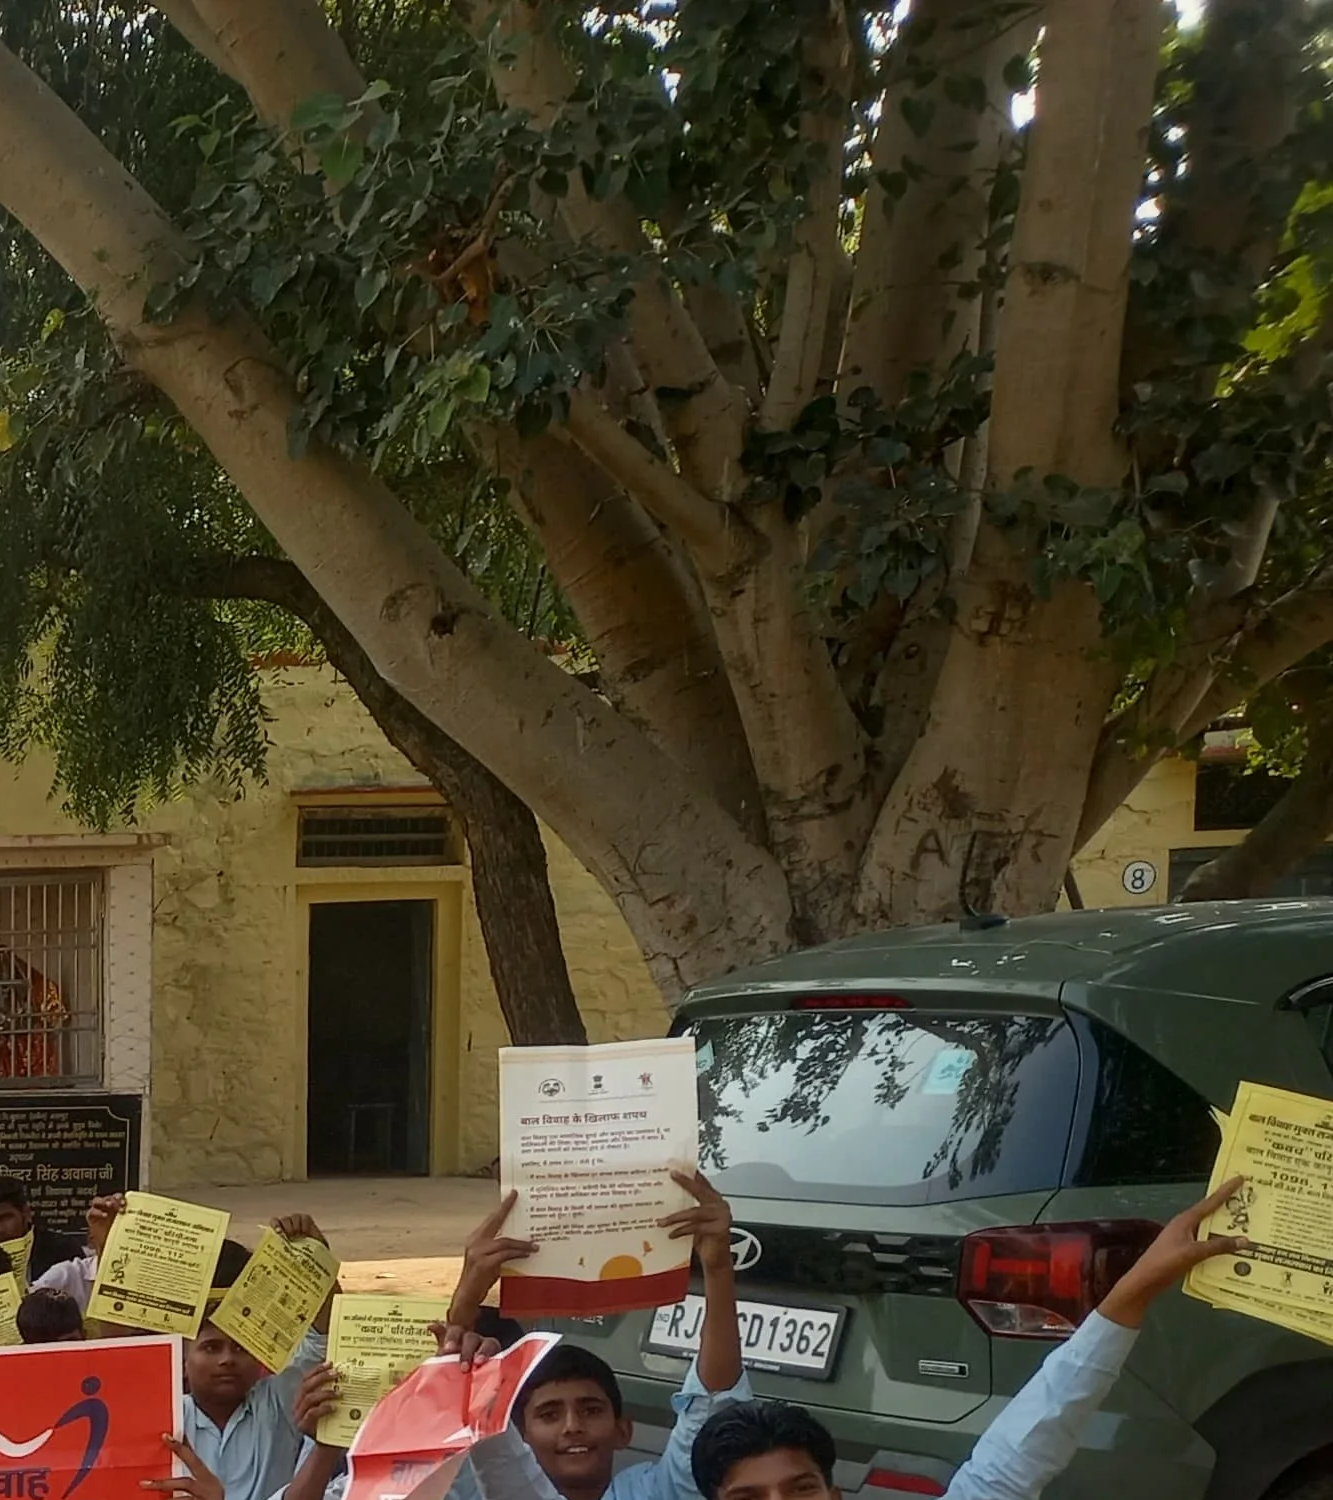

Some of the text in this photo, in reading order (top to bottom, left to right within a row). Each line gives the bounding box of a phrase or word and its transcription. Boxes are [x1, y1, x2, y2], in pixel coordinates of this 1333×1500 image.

[1130, 868, 1145, 890] 8
[520, 1116, 539, 1126] बाल
[542, 1114, 570, 1125] विवाह
[573, 1113, 582, 1123] के
[584, 1113, 620, 1124] खिलाफ
[1315, 1149, 1333, 1162] परि
[37, 1163, 60, 1182] सिंह
[61, 1167, 97, 1181] अवाना
[98, 1163, 113, 1180] जी
